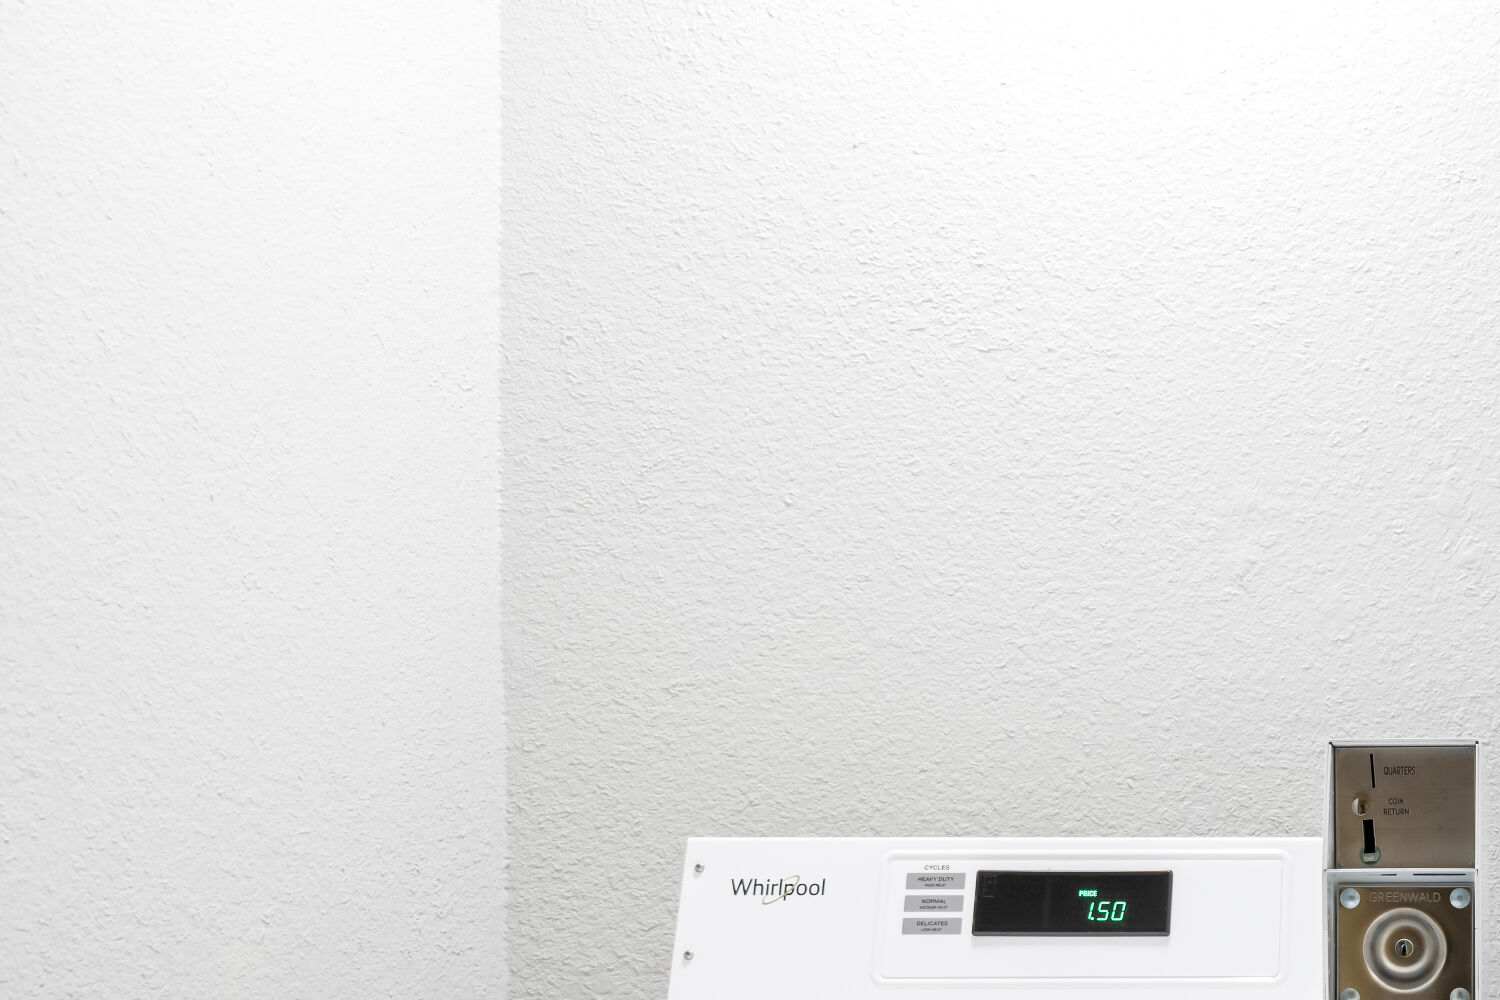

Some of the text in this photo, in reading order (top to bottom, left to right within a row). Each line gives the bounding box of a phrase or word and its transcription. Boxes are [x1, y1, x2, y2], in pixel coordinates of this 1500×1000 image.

[1383, 766, 1416, 776] QUARTERS
[1388, 797, 1404, 805] COIN
[1383, 808, 1410, 816] RETURN
[730, 878, 827, 901] Whirlpool
[1078, 889, 1098, 898] PRICE
[1369, 891, 1442, 903] GREENWALD
[1087, 900, 1127, 922] 1.50
